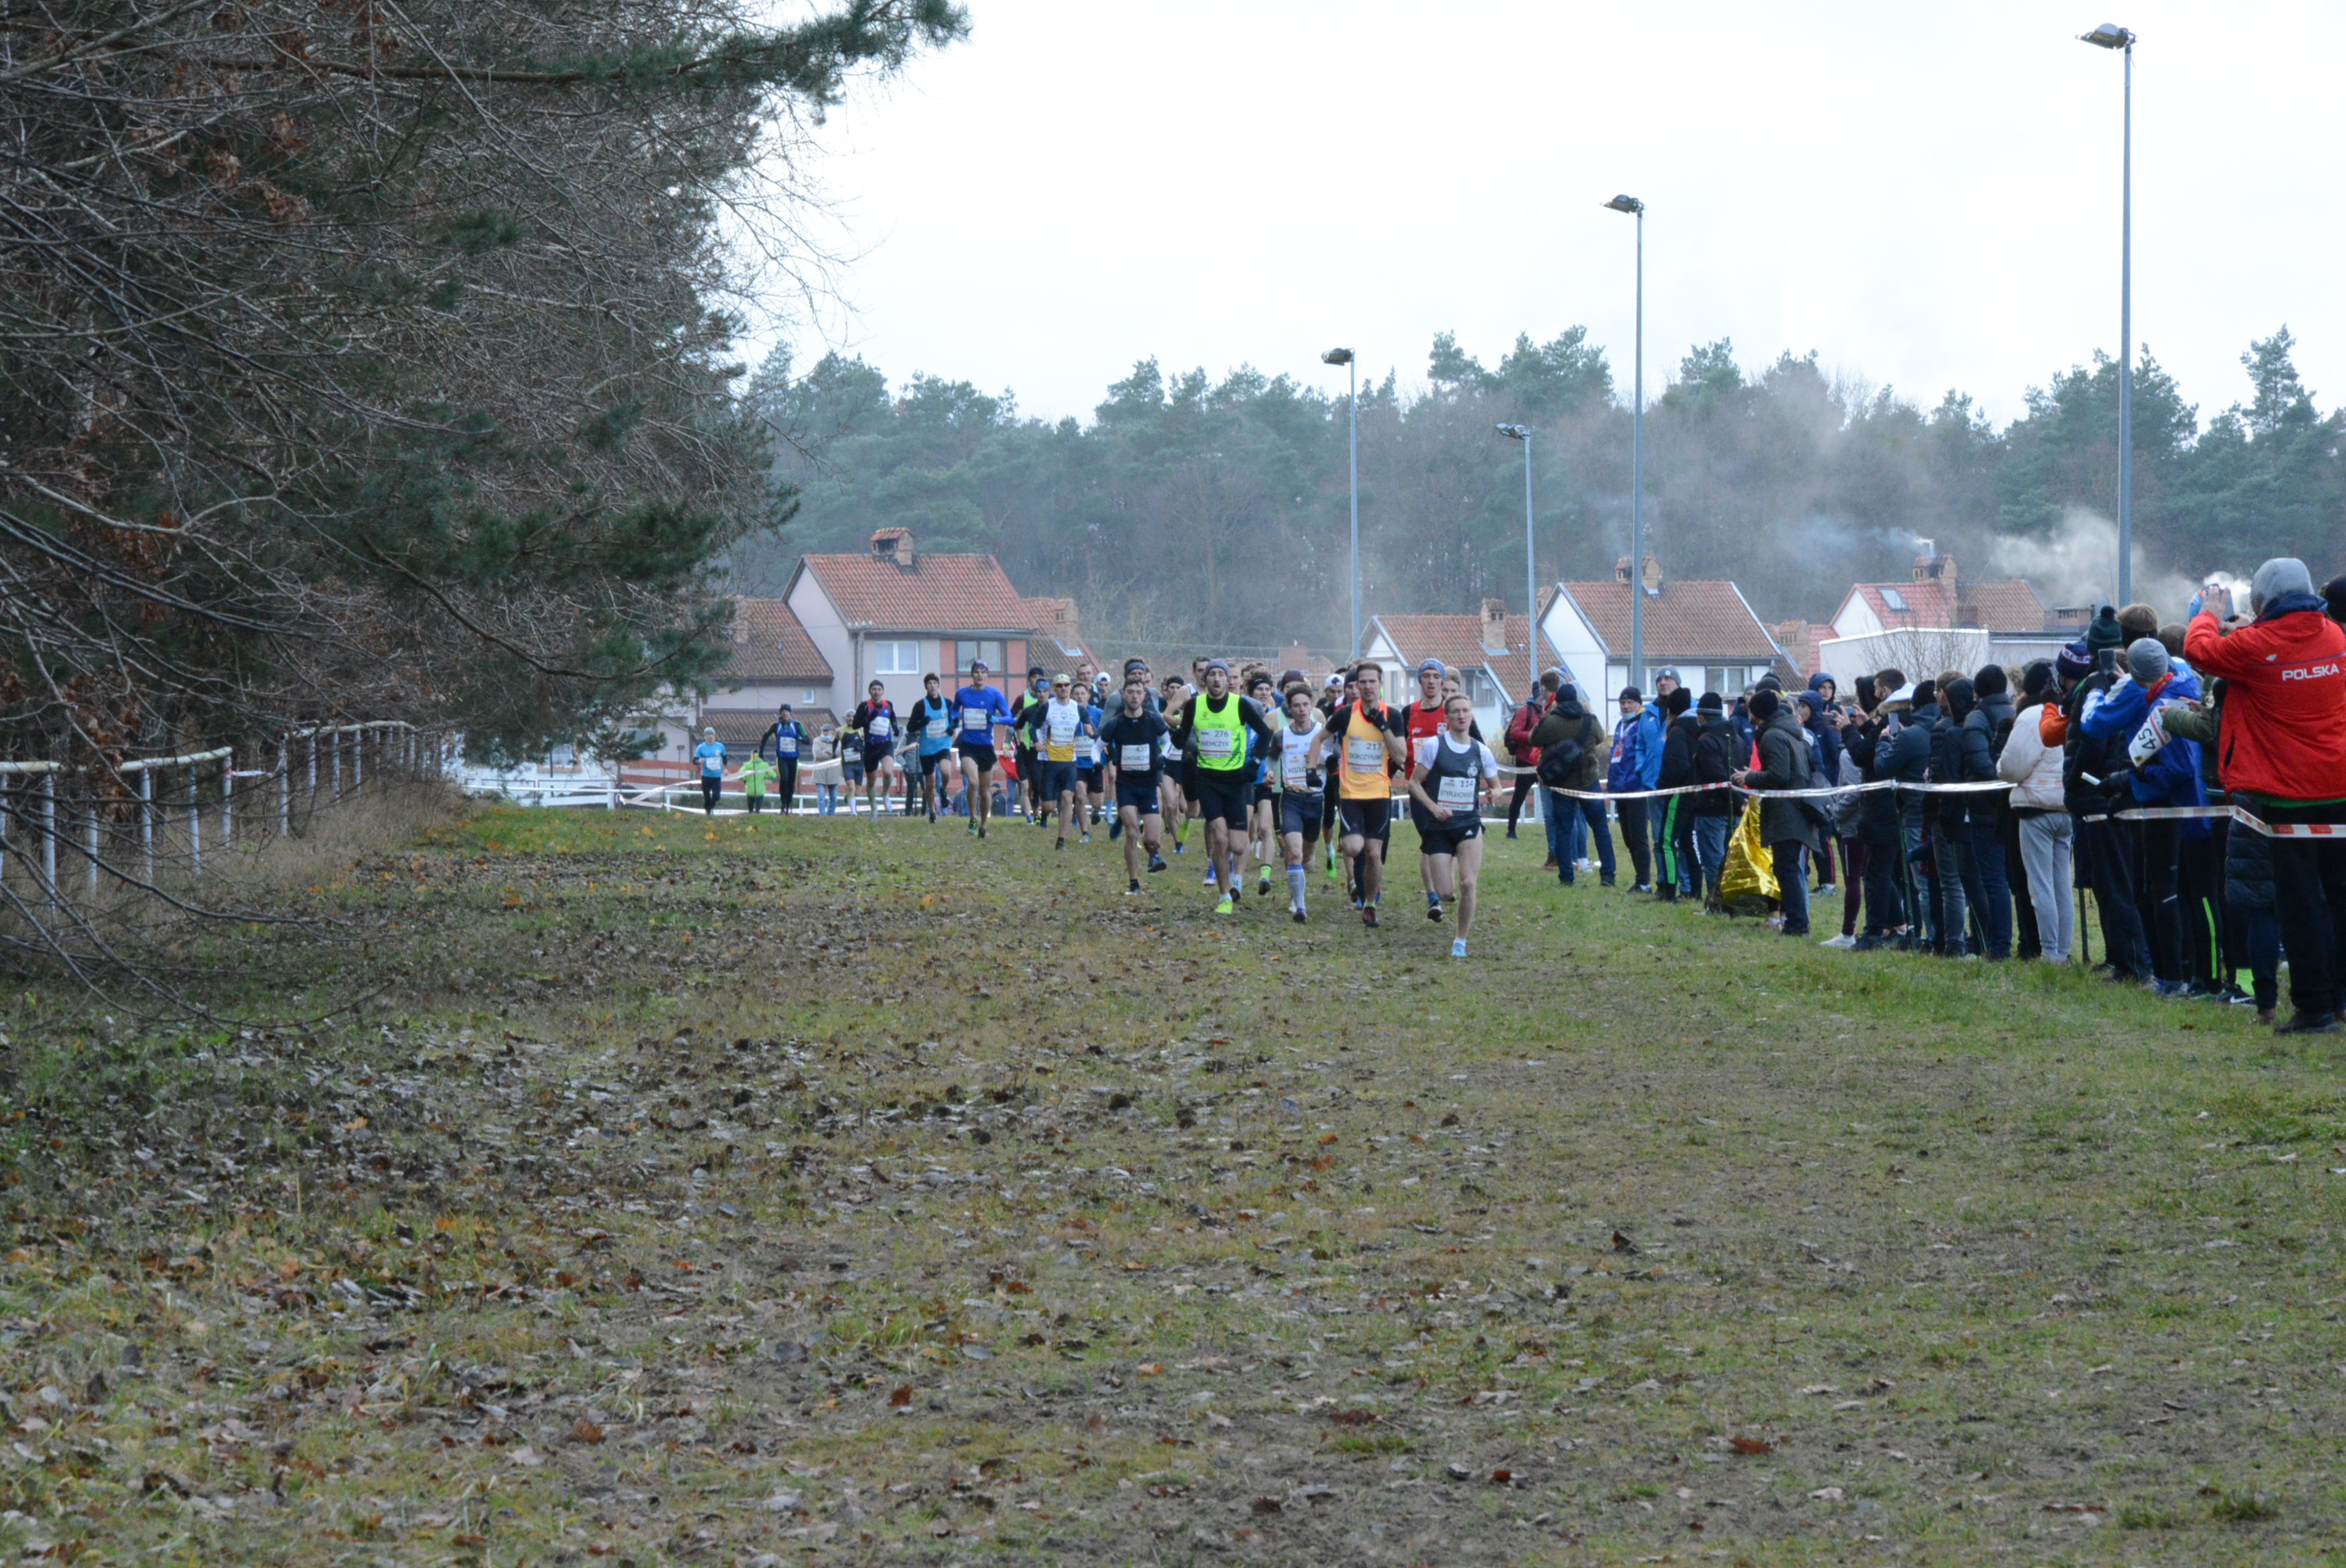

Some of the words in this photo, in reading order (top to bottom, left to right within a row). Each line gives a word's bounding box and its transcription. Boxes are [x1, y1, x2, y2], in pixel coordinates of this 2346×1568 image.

[2282, 663, 2341, 681] POLSKA
[1366, 742, 1382, 751] 217
[1460, 779, 1473, 788] 114
